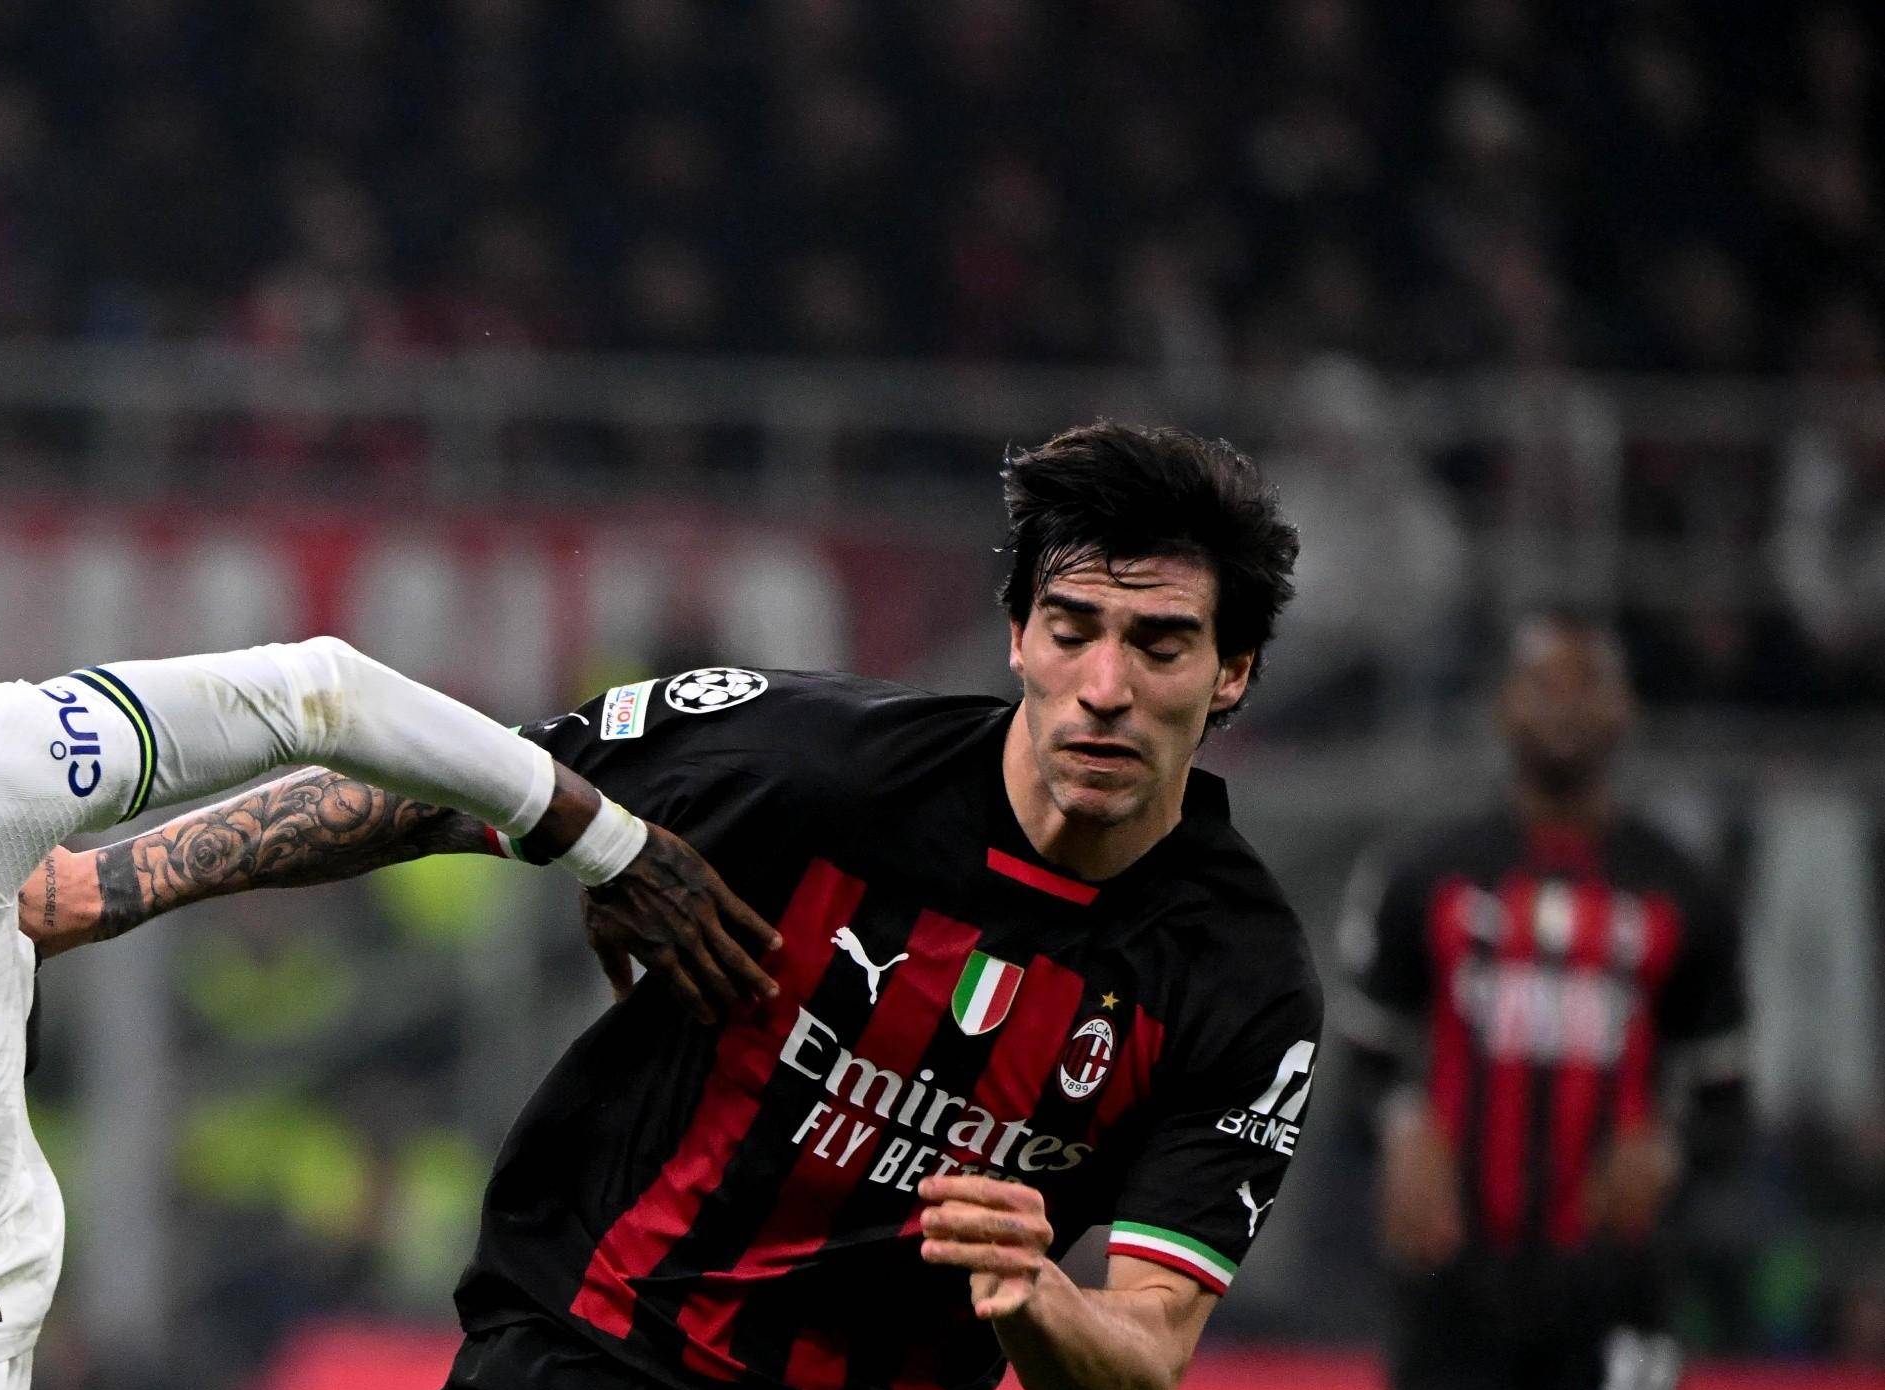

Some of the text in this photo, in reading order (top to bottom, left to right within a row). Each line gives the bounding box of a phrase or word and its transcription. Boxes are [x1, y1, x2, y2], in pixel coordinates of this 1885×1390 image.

[1082, 1021, 1111, 1042] ACM
[779, 1004, 1093, 1172] Emirates
[1063, 1078, 1090, 1094] 1899
[791, 1100, 1024, 1193] FLY BET
